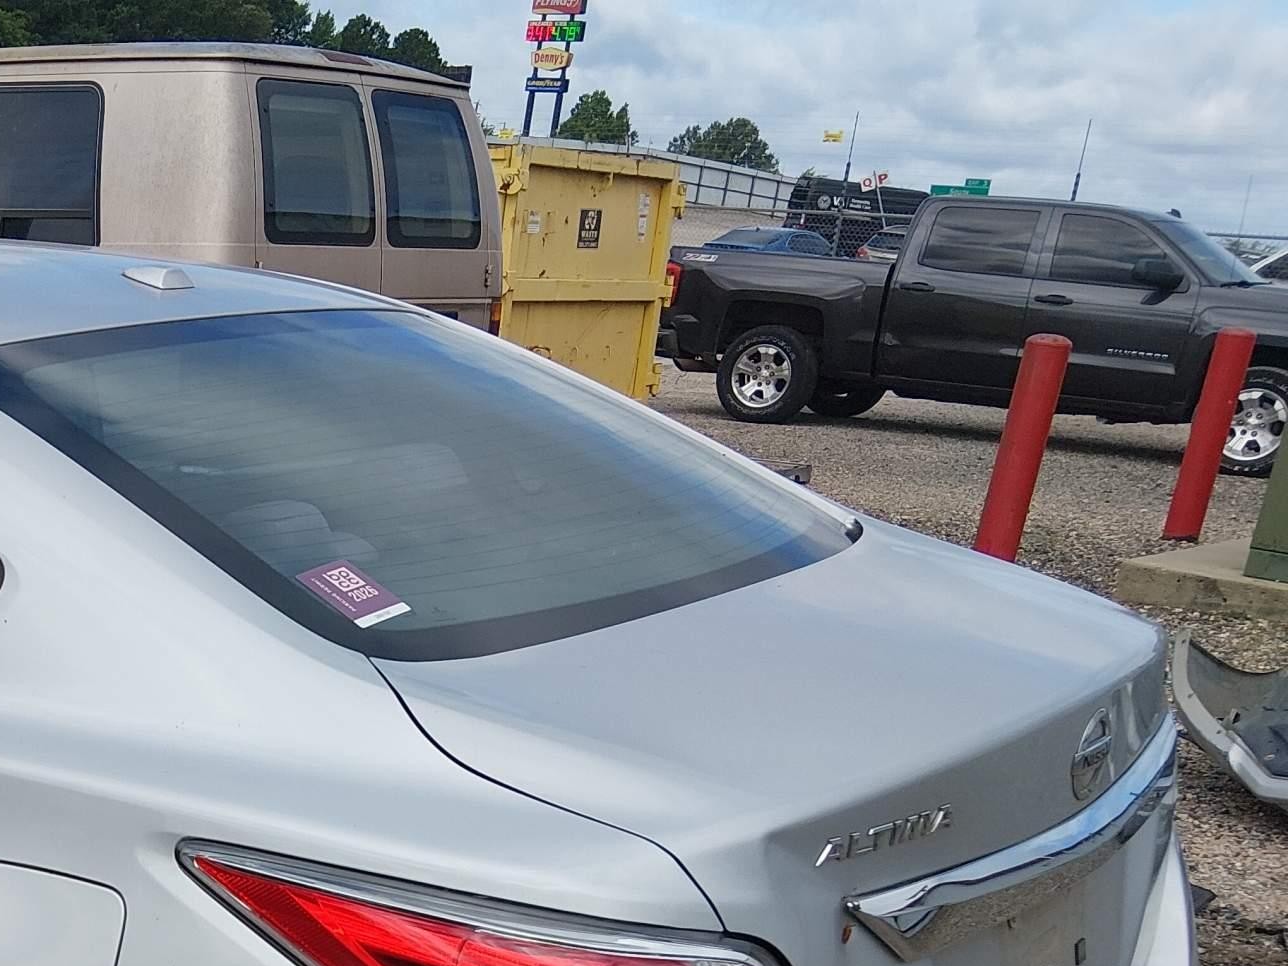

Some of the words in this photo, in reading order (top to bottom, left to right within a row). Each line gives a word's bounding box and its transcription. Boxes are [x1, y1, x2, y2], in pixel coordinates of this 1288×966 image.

[534, 53, 564, 65] Denny's
[863, 178, 872, 187] Q
[878, 173, 888, 184] P
[347, 585, 380, 602] 2026
[815, 802, 951, 867] ALTIMA
